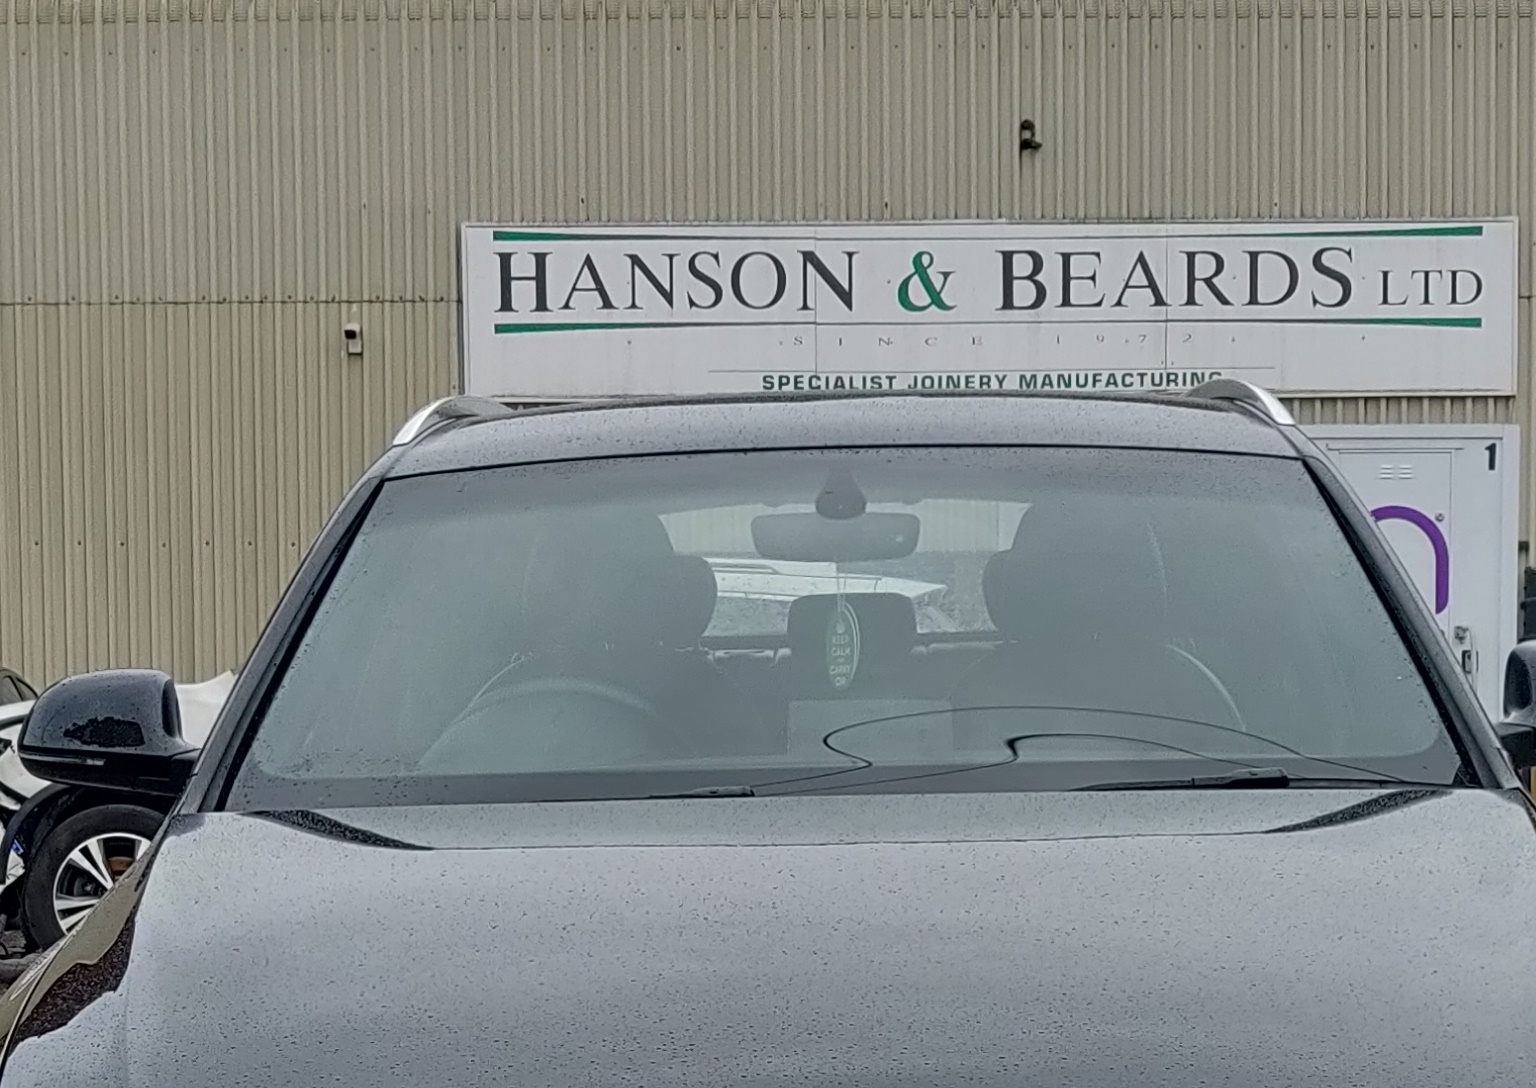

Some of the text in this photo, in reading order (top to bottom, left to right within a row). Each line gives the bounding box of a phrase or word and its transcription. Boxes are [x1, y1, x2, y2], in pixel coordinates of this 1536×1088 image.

[493, 246, 1484, 313] HANSON & BEARDS LTD
[762, 374, 897, 391] SPECIALIST
[907, 373, 1008, 390] JOINERY
[1484, 442, 1498, 471] 1
